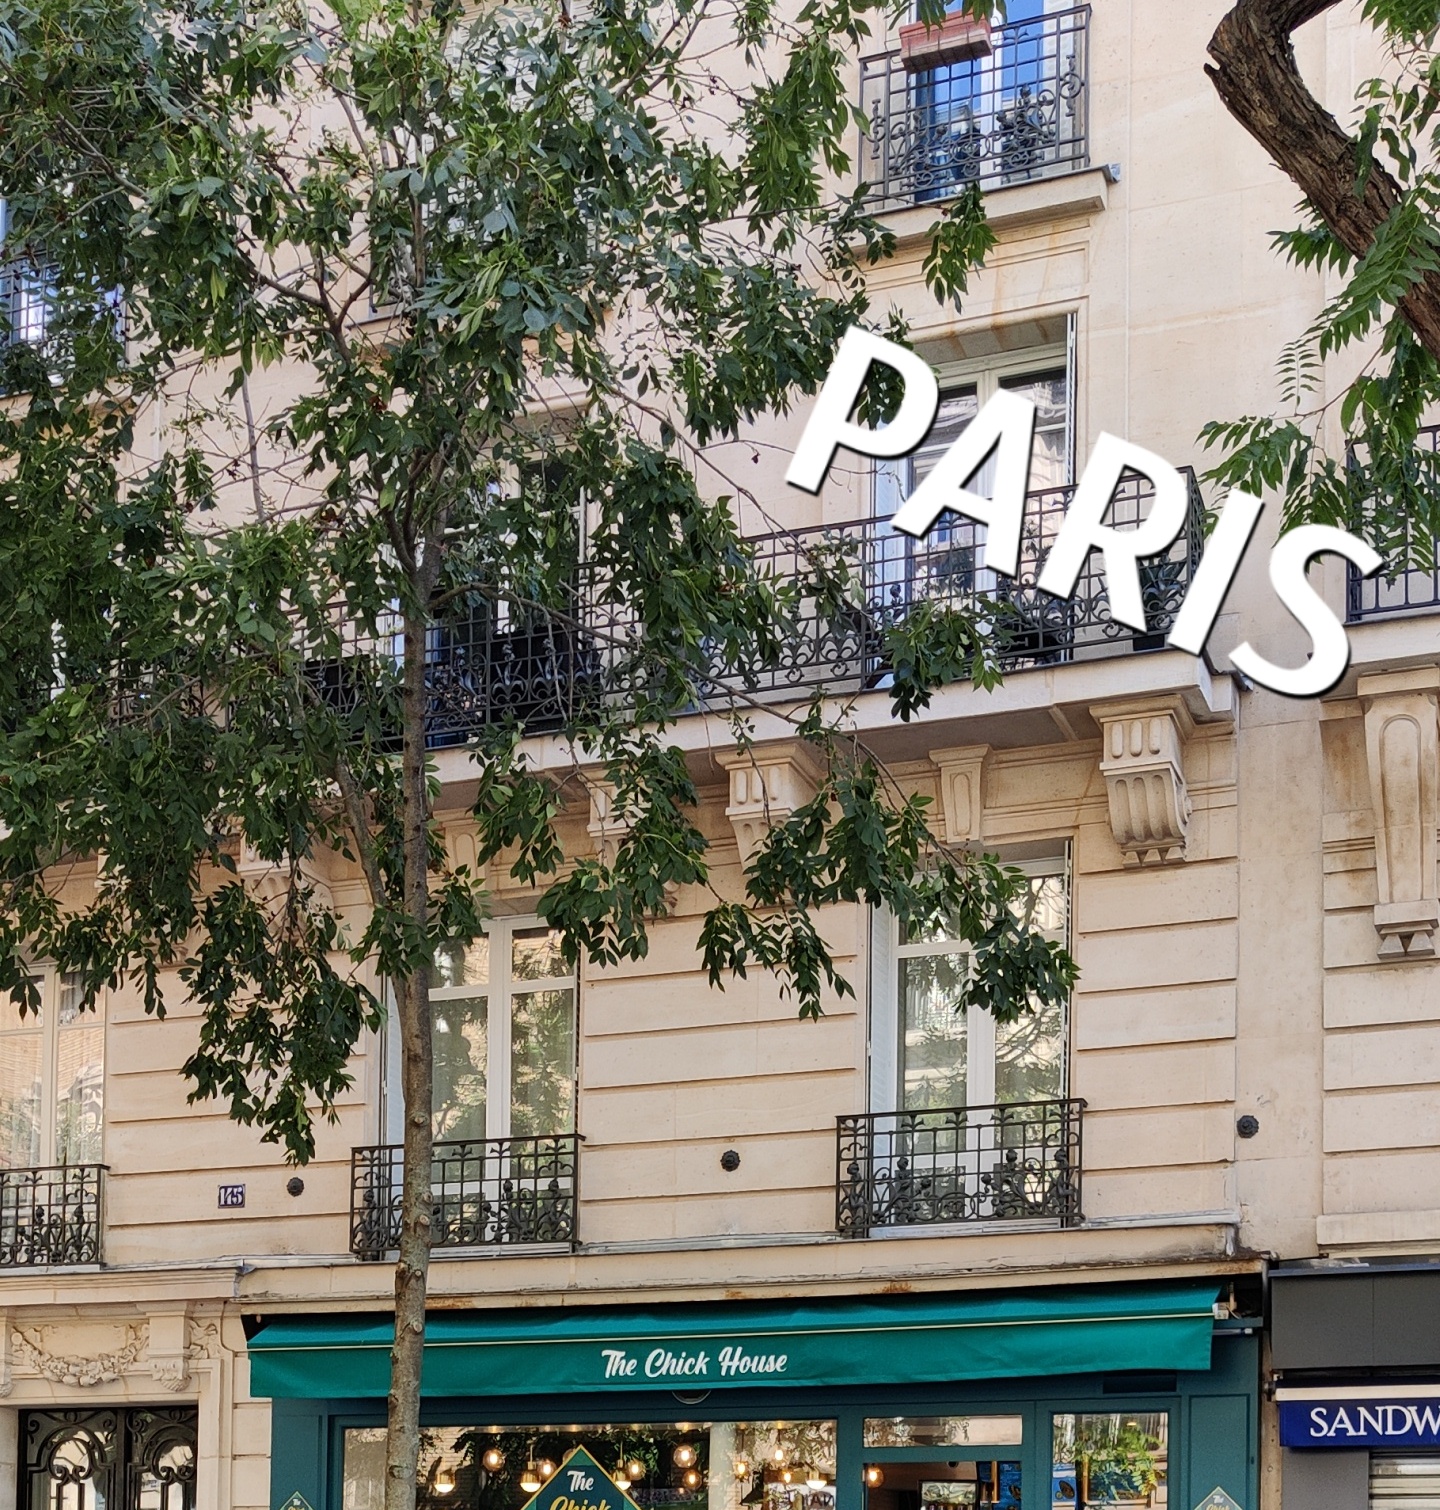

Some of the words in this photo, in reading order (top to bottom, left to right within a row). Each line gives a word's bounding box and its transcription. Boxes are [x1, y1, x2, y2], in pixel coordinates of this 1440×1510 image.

[220, 1187, 243, 1205] 145
[601, 1350, 638, 1378] The
[644, 1348, 710, 1378] Chick
[718, 1346, 788, 1376] House
[566, 1470, 594, 1493] The
